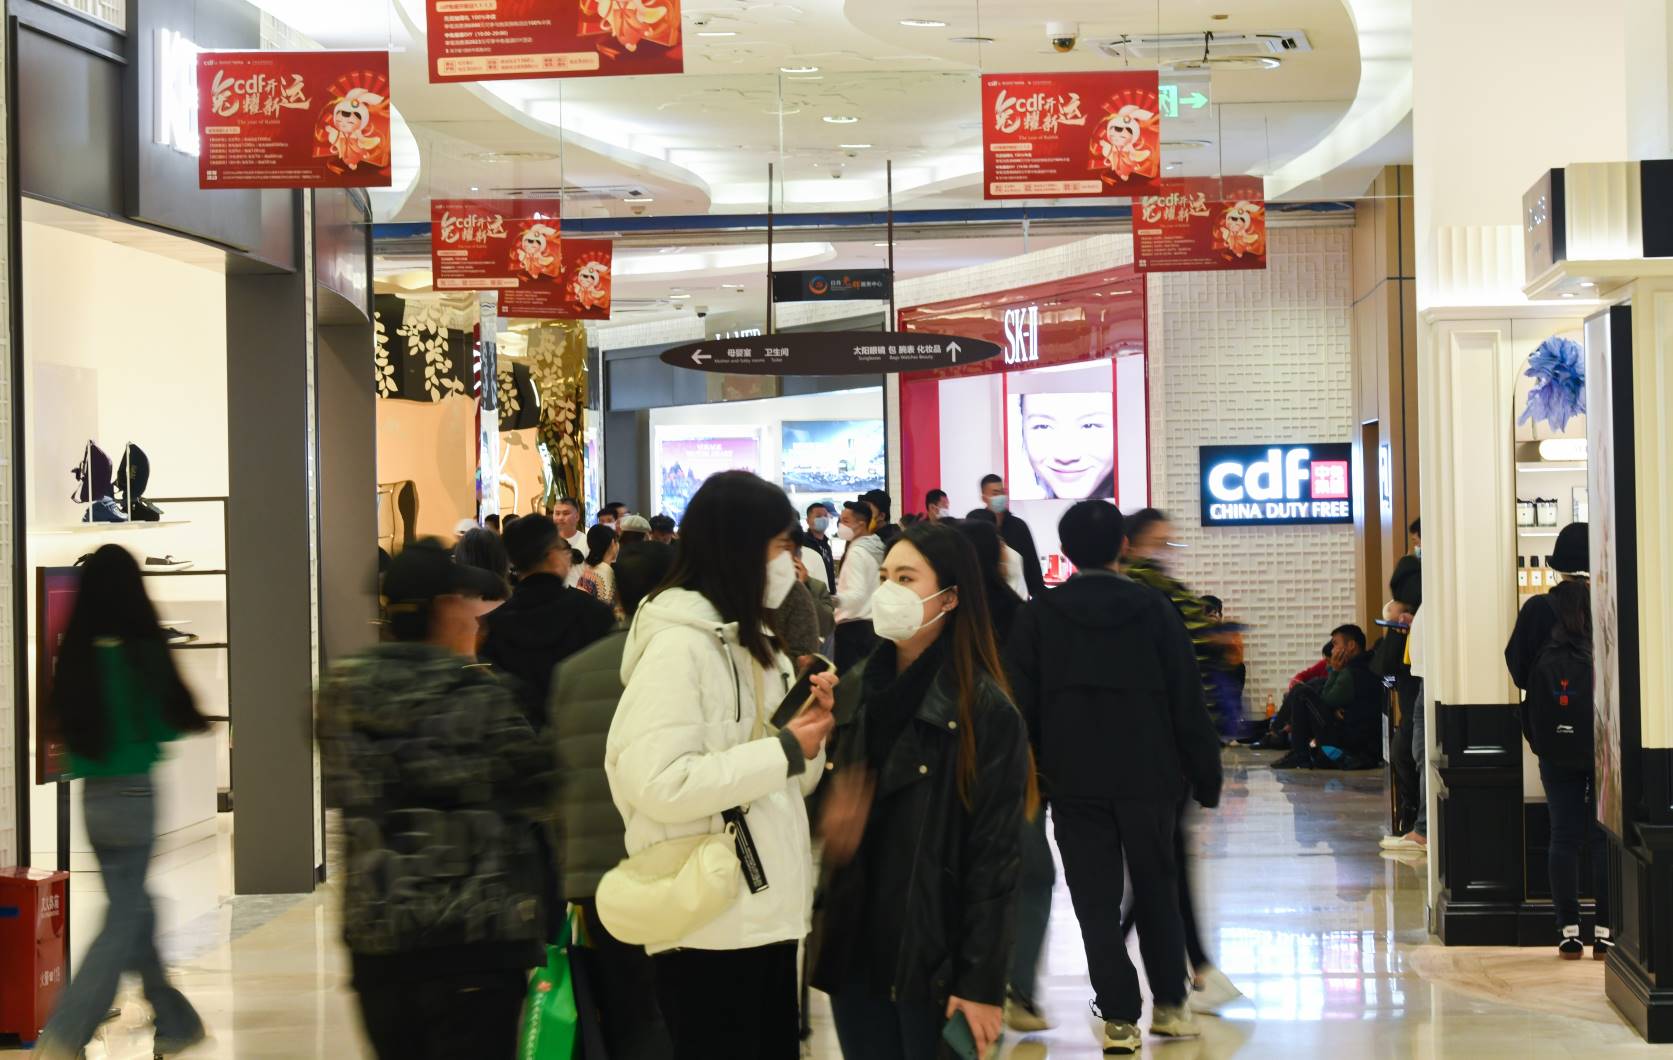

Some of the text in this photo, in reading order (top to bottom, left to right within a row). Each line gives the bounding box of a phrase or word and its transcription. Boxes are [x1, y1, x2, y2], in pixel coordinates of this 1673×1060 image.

[727, 344, 942, 358] 母婴室 卫生间 太阳眼镜 包 腕表 化妆品
[1208, 448, 1309, 501] cdf
[1209, 501, 1349, 520] CHINA DUTY FREE
